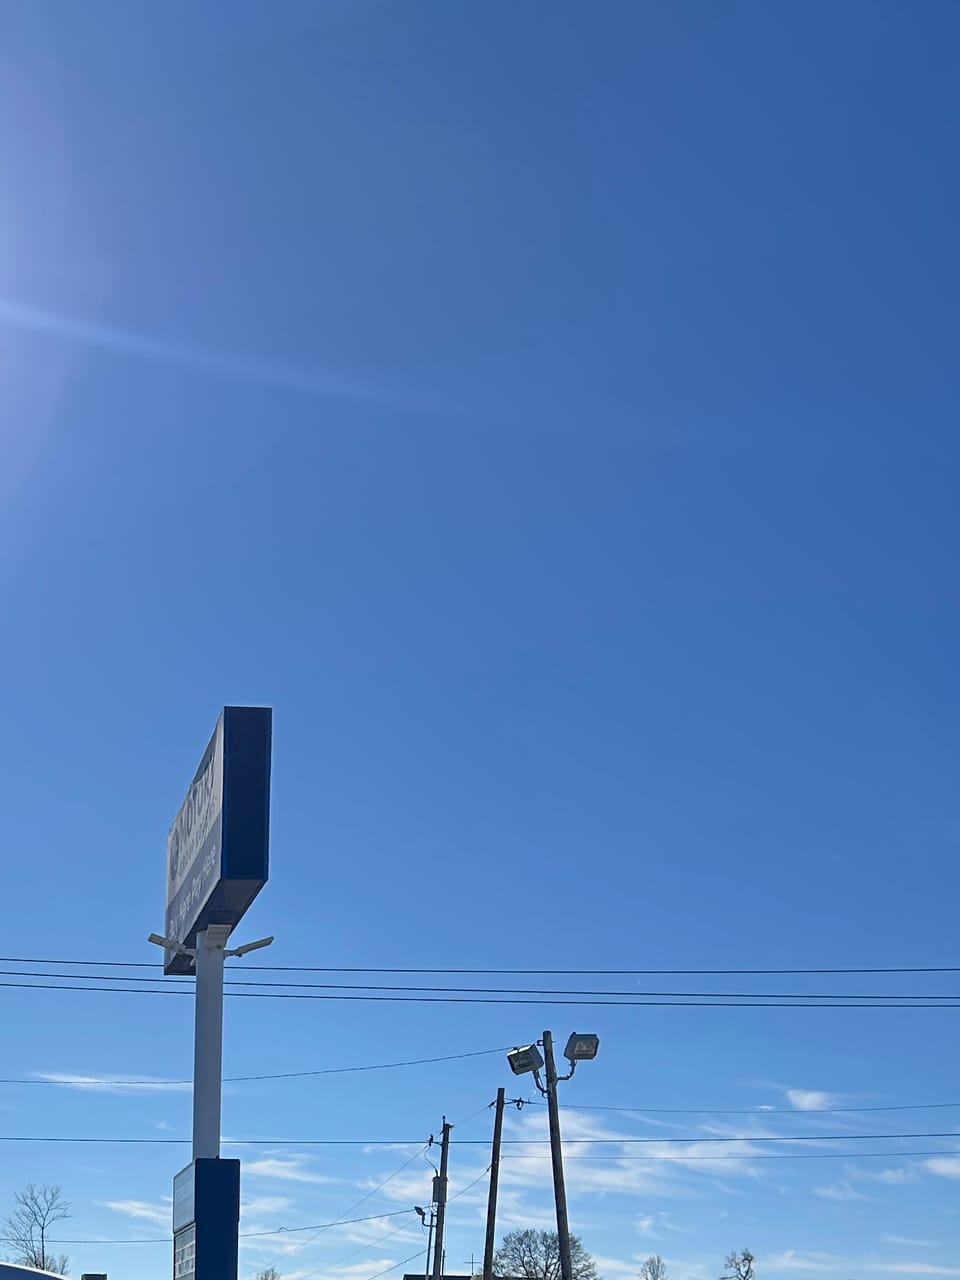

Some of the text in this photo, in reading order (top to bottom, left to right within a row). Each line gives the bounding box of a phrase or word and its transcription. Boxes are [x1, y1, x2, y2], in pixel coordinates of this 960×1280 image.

[179, 891, 191, 920] Here
[191, 871, 202, 905] Pay
[202, 844, 216, 876] Here
